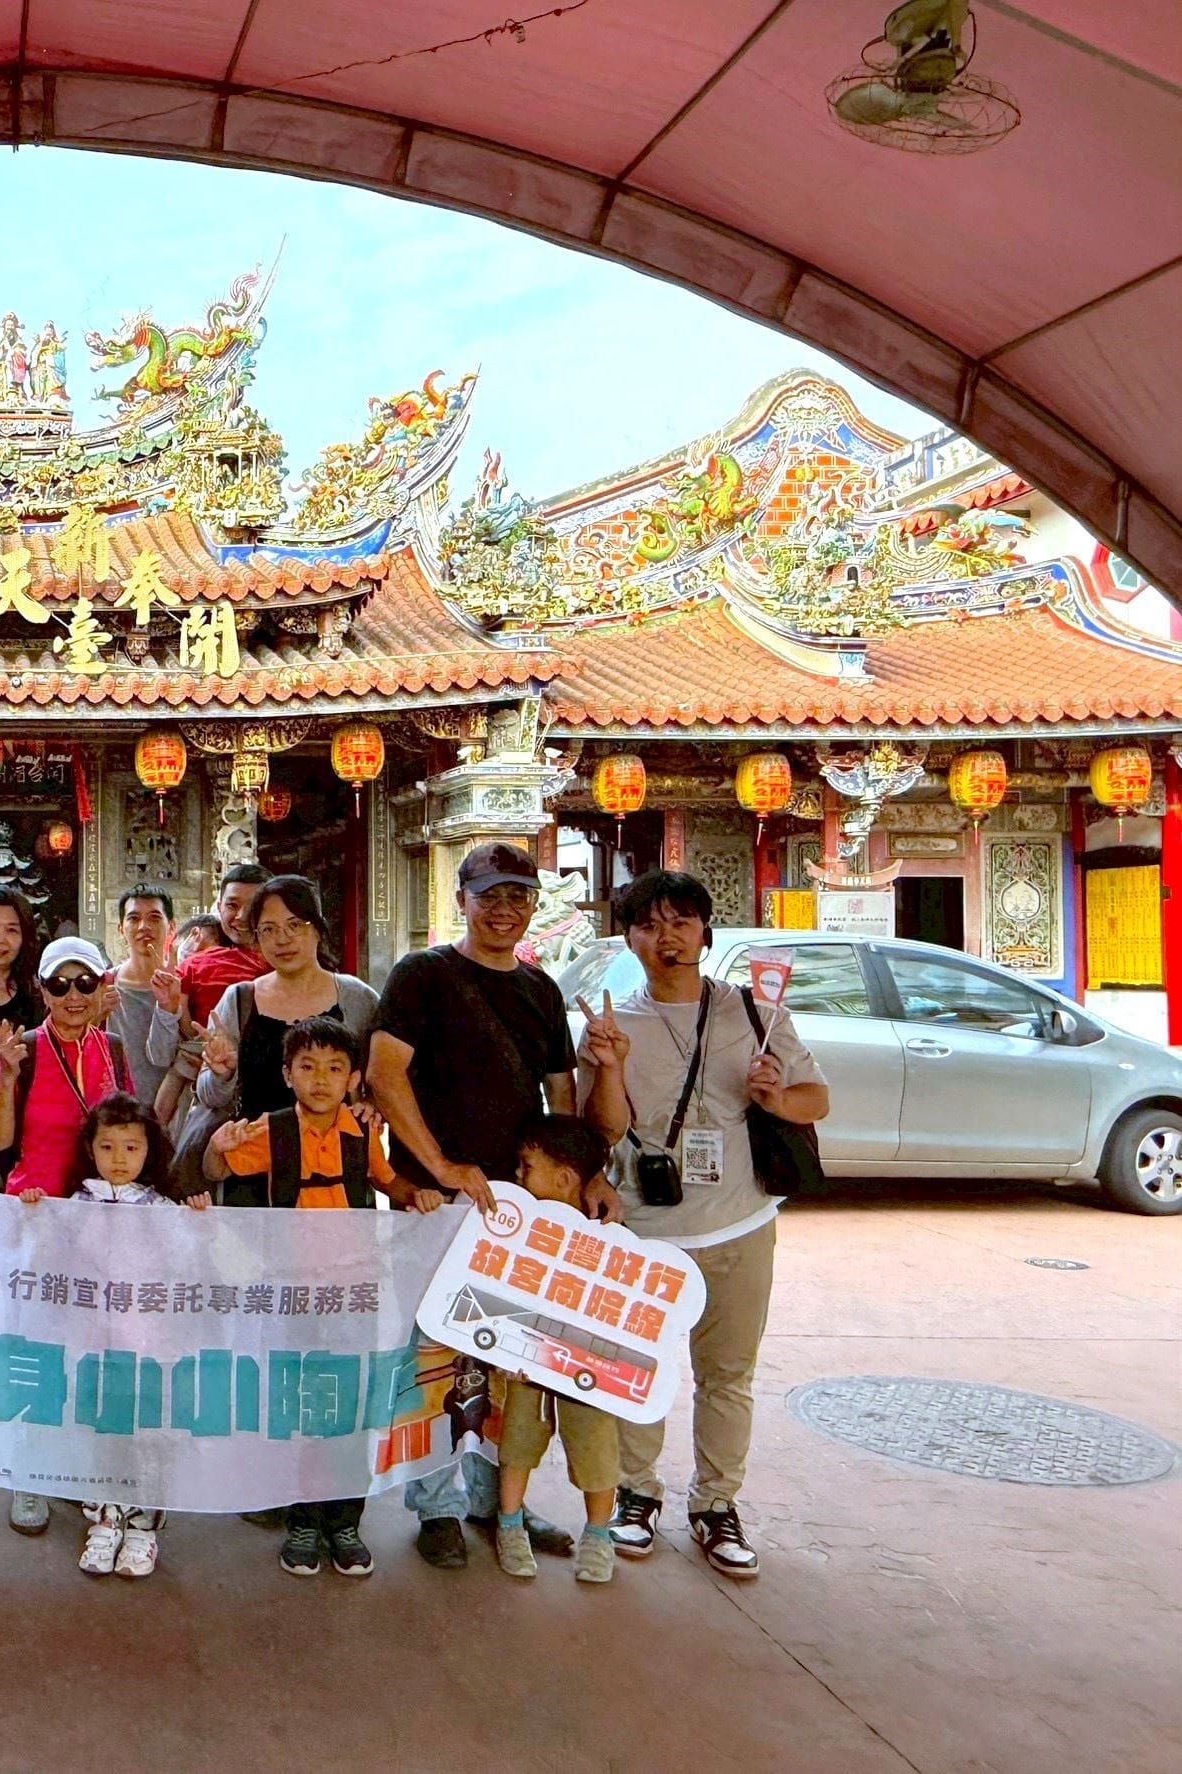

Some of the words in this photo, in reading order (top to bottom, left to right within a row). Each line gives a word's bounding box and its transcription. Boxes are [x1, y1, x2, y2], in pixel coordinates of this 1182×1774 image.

[489, 1209, 516, 1229] 106
[525, 1217, 687, 1303] 台灣好行
[468, 1239, 667, 1343] 故宮南院線
